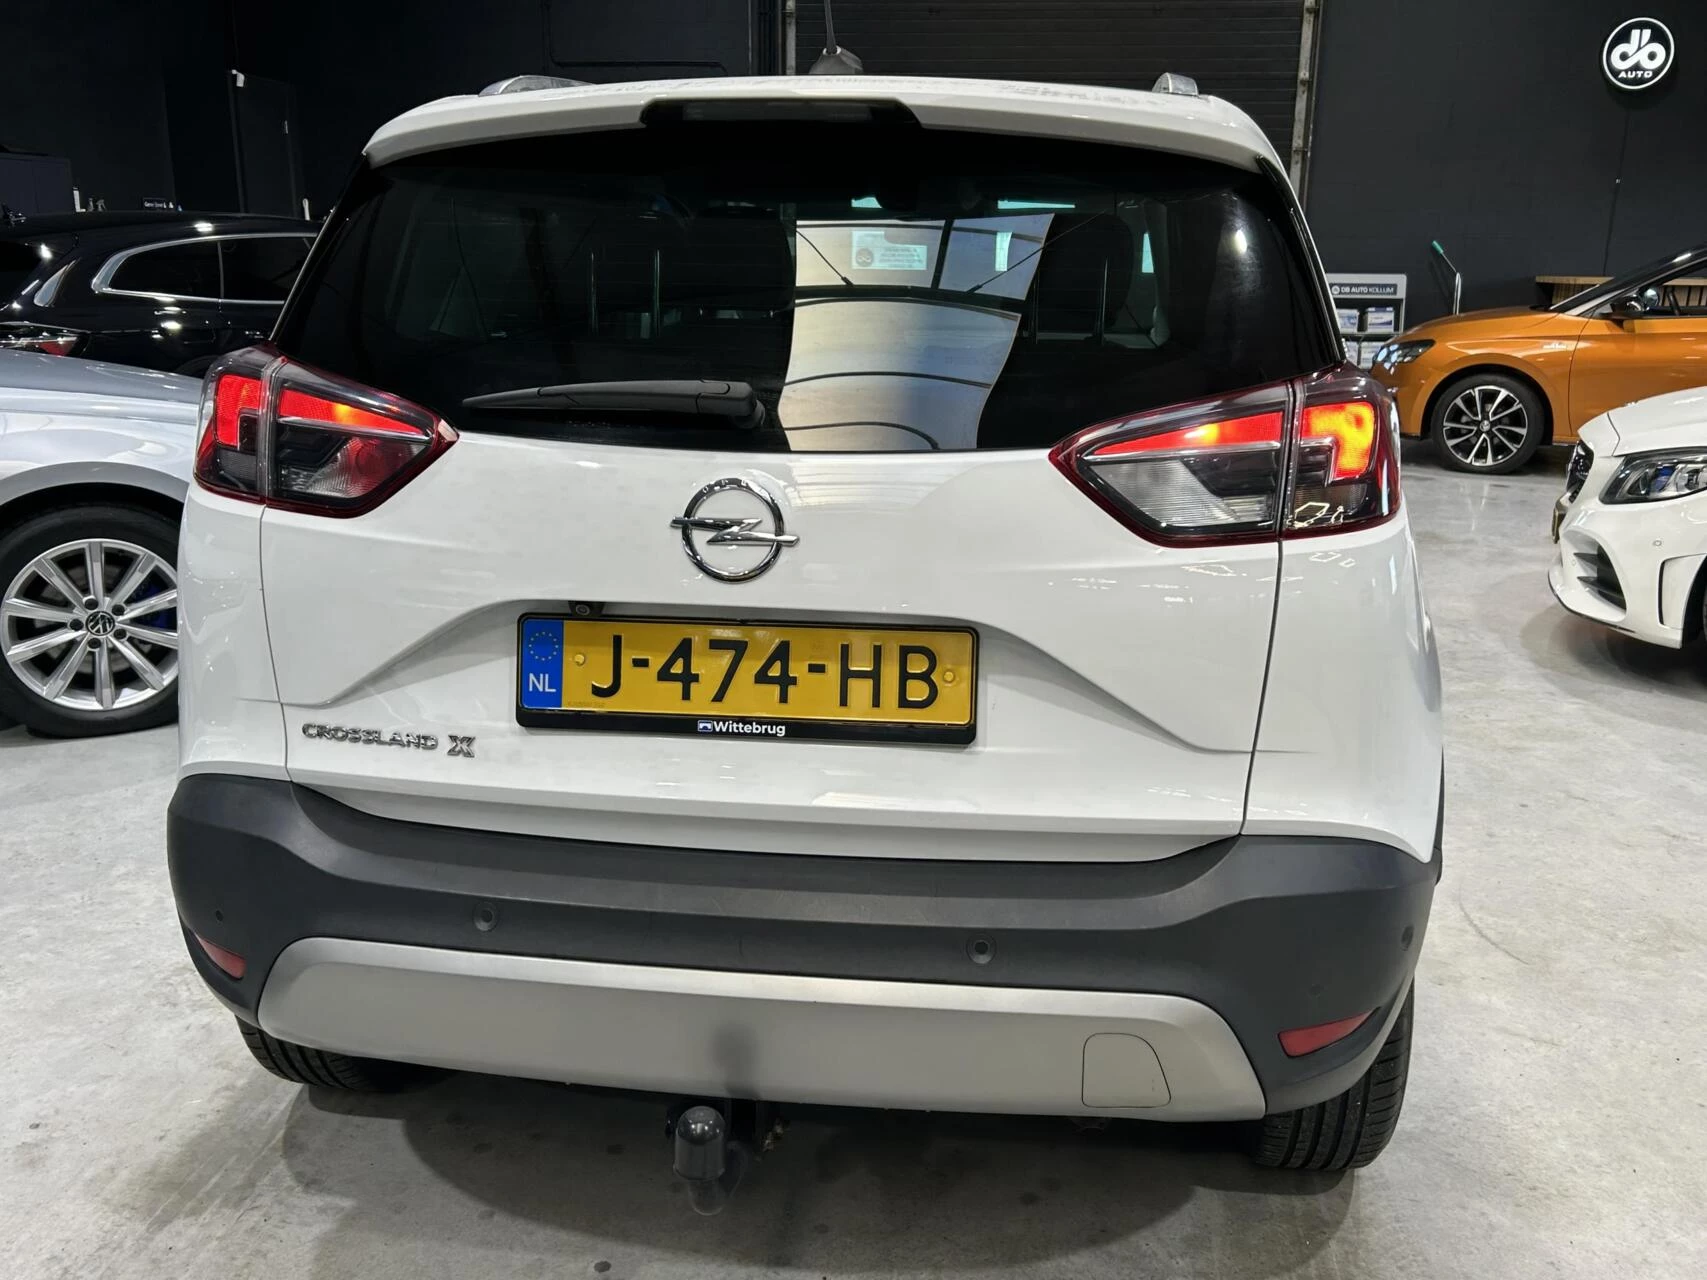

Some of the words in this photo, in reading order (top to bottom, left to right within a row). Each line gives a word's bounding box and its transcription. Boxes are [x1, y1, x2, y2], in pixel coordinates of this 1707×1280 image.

[1618, 70, 1653, 78] AUTO
[1351, 285, 1368, 293] AUTO
[591, 634, 938, 708] J-474-HB
[528, 673, 556, 692] NL
[713, 720, 786, 737] Wittebrug
[301, 723, 438, 750] CROSSLAND
[447, 735, 475, 757] X
